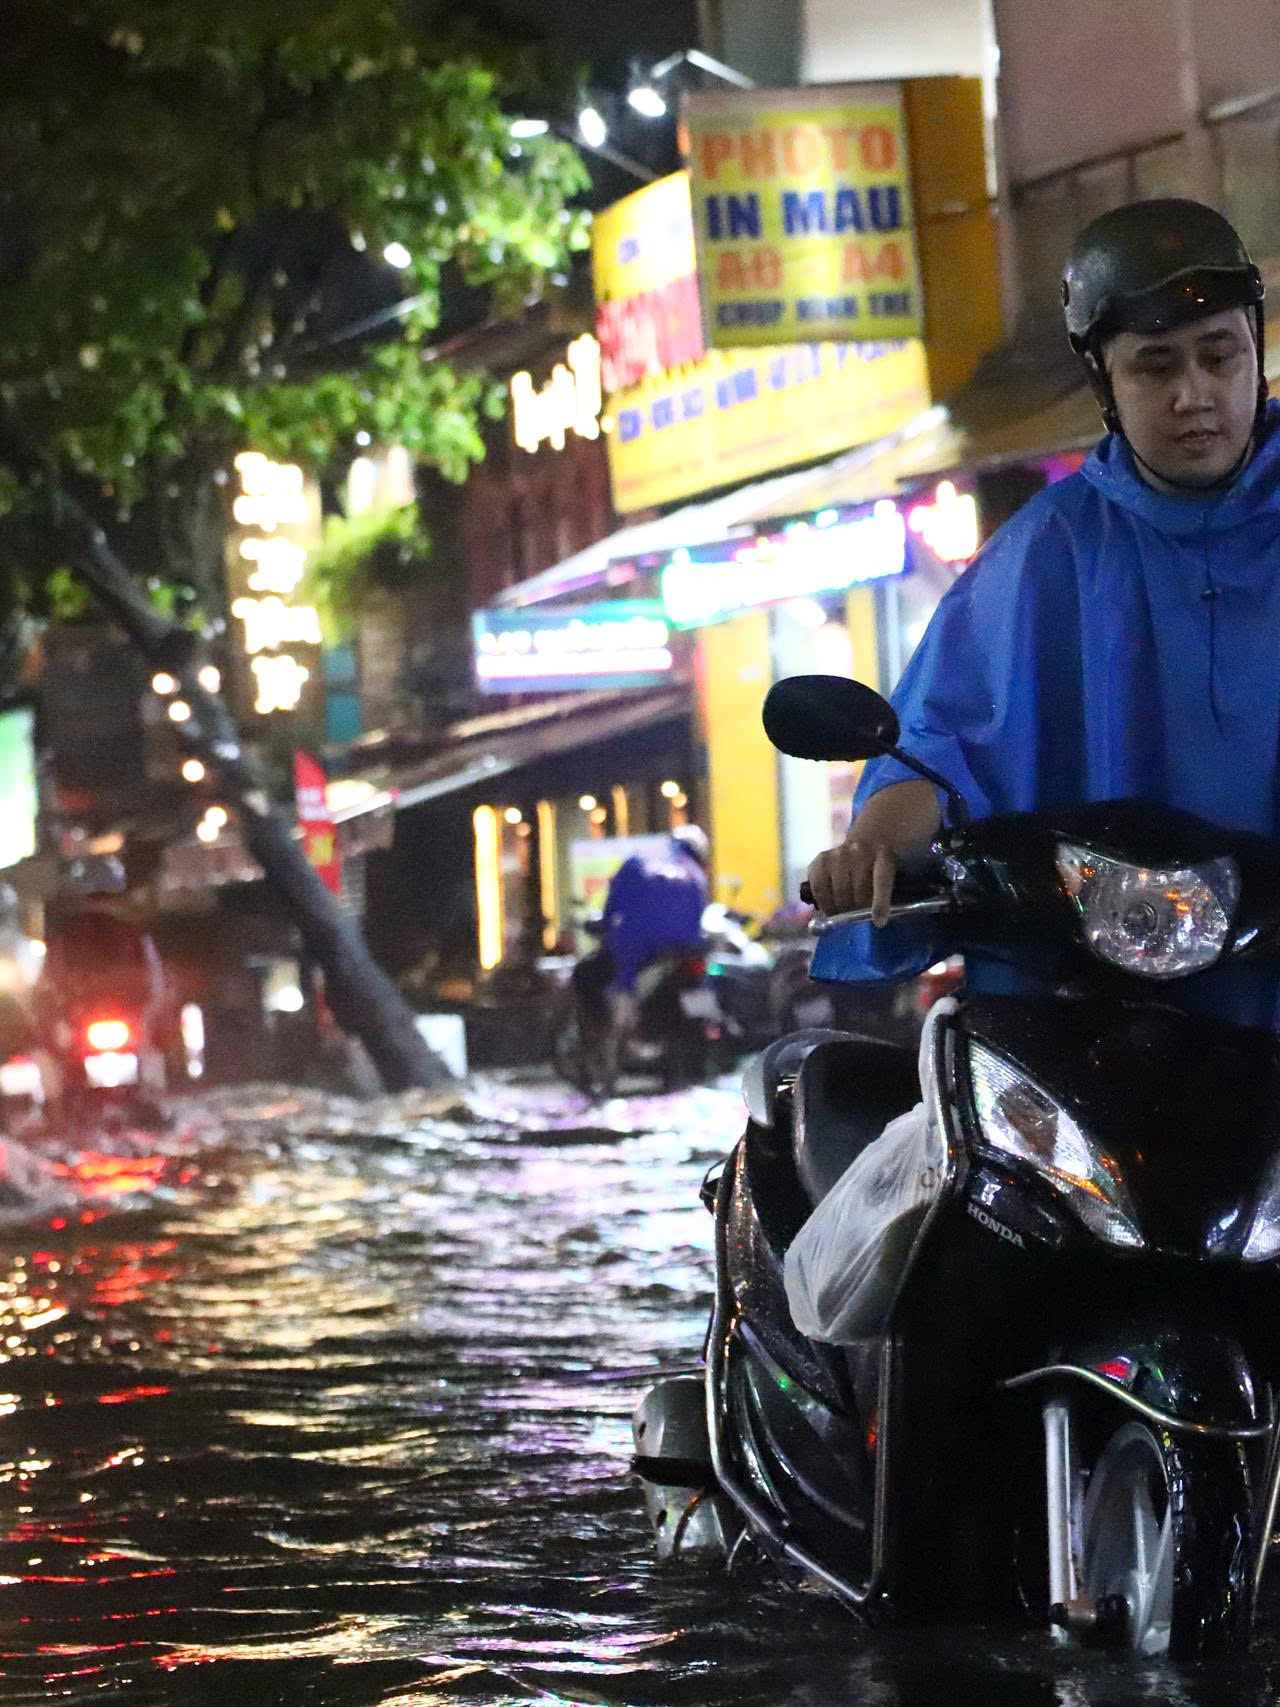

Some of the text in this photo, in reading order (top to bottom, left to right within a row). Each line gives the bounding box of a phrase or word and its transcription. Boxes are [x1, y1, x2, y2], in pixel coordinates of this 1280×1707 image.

[700, 127, 896, 181] PHOTO
[706, 192, 761, 238] IN
[967, 1201, 1025, 1249] HONDA
